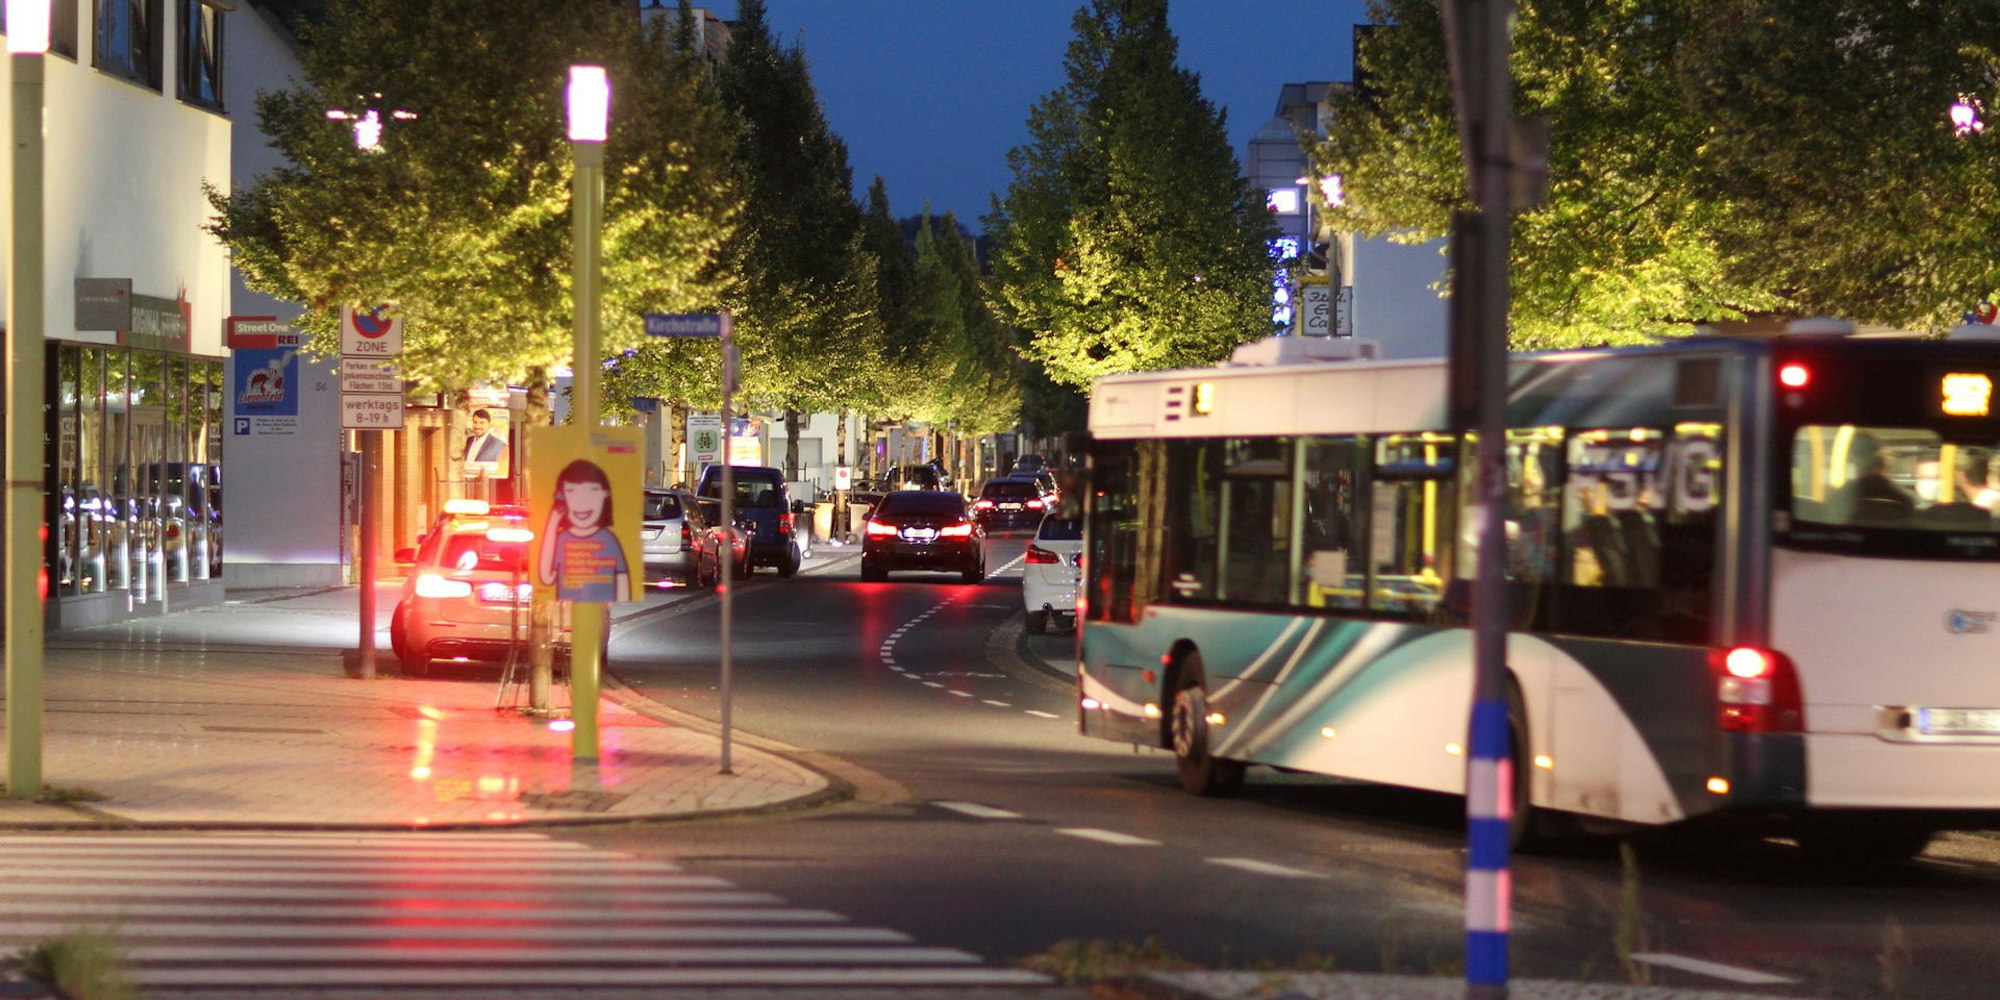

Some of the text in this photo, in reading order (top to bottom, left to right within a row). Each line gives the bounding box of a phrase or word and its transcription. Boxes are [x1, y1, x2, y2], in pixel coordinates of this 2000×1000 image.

[237, 323, 289, 333] Street One
[356, 341, 388, 352] ZONE
[345, 400, 400, 413] werktags
[355, 413, 390, 424] 8-19 h
